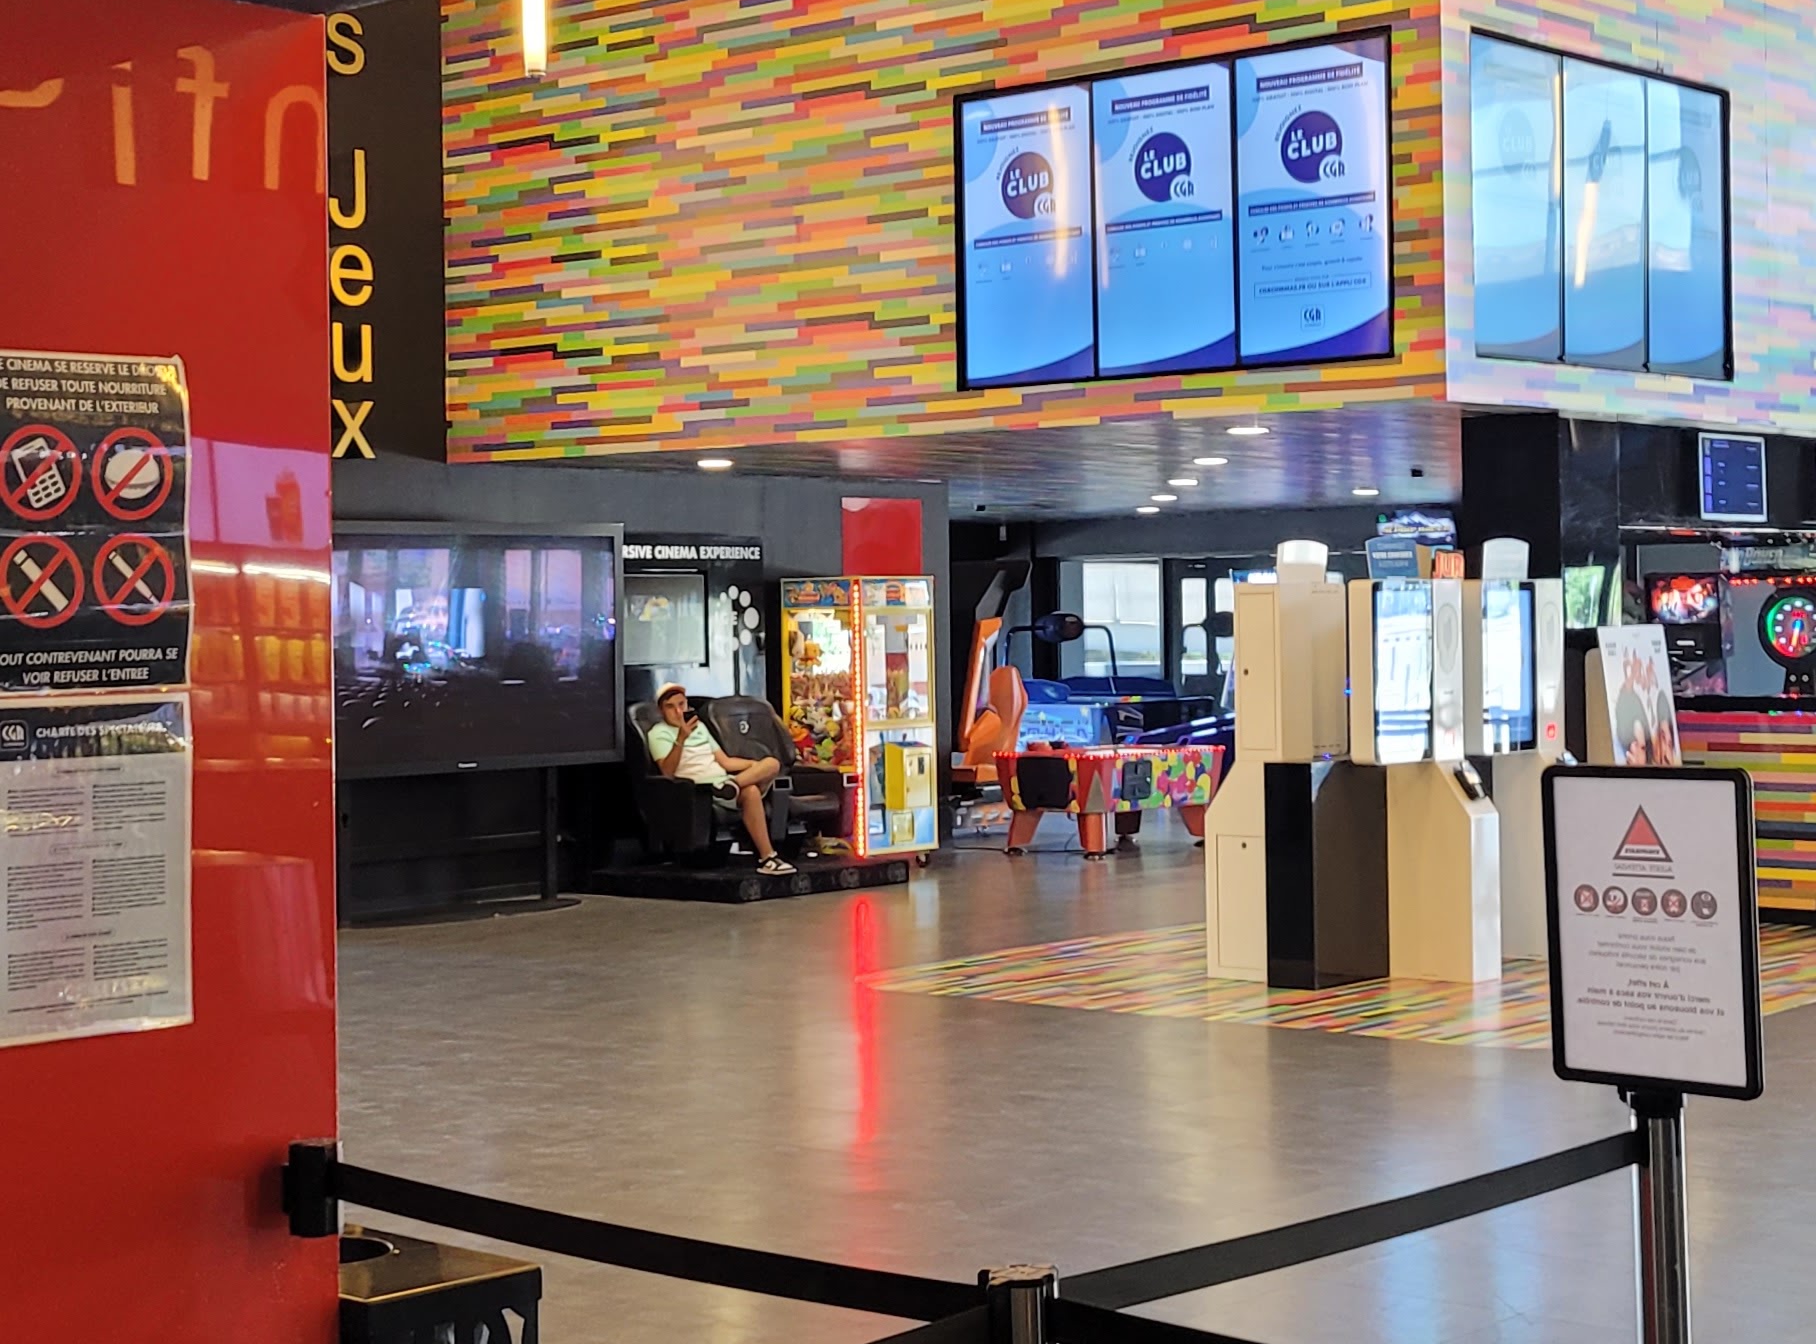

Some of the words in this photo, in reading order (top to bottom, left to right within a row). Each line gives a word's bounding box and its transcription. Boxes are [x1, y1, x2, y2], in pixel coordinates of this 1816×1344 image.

[1290, 128, 1305, 141] LE
[1143, 149, 1156, 162] LE
[1287, 132, 1338, 161] CLUB
[1009, 168, 1022, 180] LE
[1140, 152, 1188, 180] CLUB
[1006, 171, 1050, 198] CLUB
[327, 149, 375, 459] Jeux
[6, 358, 53, 373] CINEMA
[54, 361, 70, 373] SE
[70, 362, 117, 376] RESERVE
[117, 364, 131, 376] LE
[11, 378, 60, 392] REFUSER
[60, 379, 97, 394] TOUTE
[98, 382, 168, 396] NOURRITURE
[5, 396, 78, 412] PROVENANT
[78, 399, 93, 412] DE
[95, 399, 160, 415] L'EXTERIEUR
[653, 545, 699, 560] CINEMA
[699, 546, 761, 561] EXPERIENCE
[0, 653, 25, 667] OUT
[25, 650, 117, 666] CONTREVENANT
[118, 648, 163, 662] POURRA
[165, 647, 180, 660] SE
[23, 672, 51, 686] VOIR
[53, 669, 100, 684] REFUSER
[101, 667, 150, 682] L'ENTREE
[36, 726, 76, 739] CHARTE
[77, 726, 97, 737] DES
